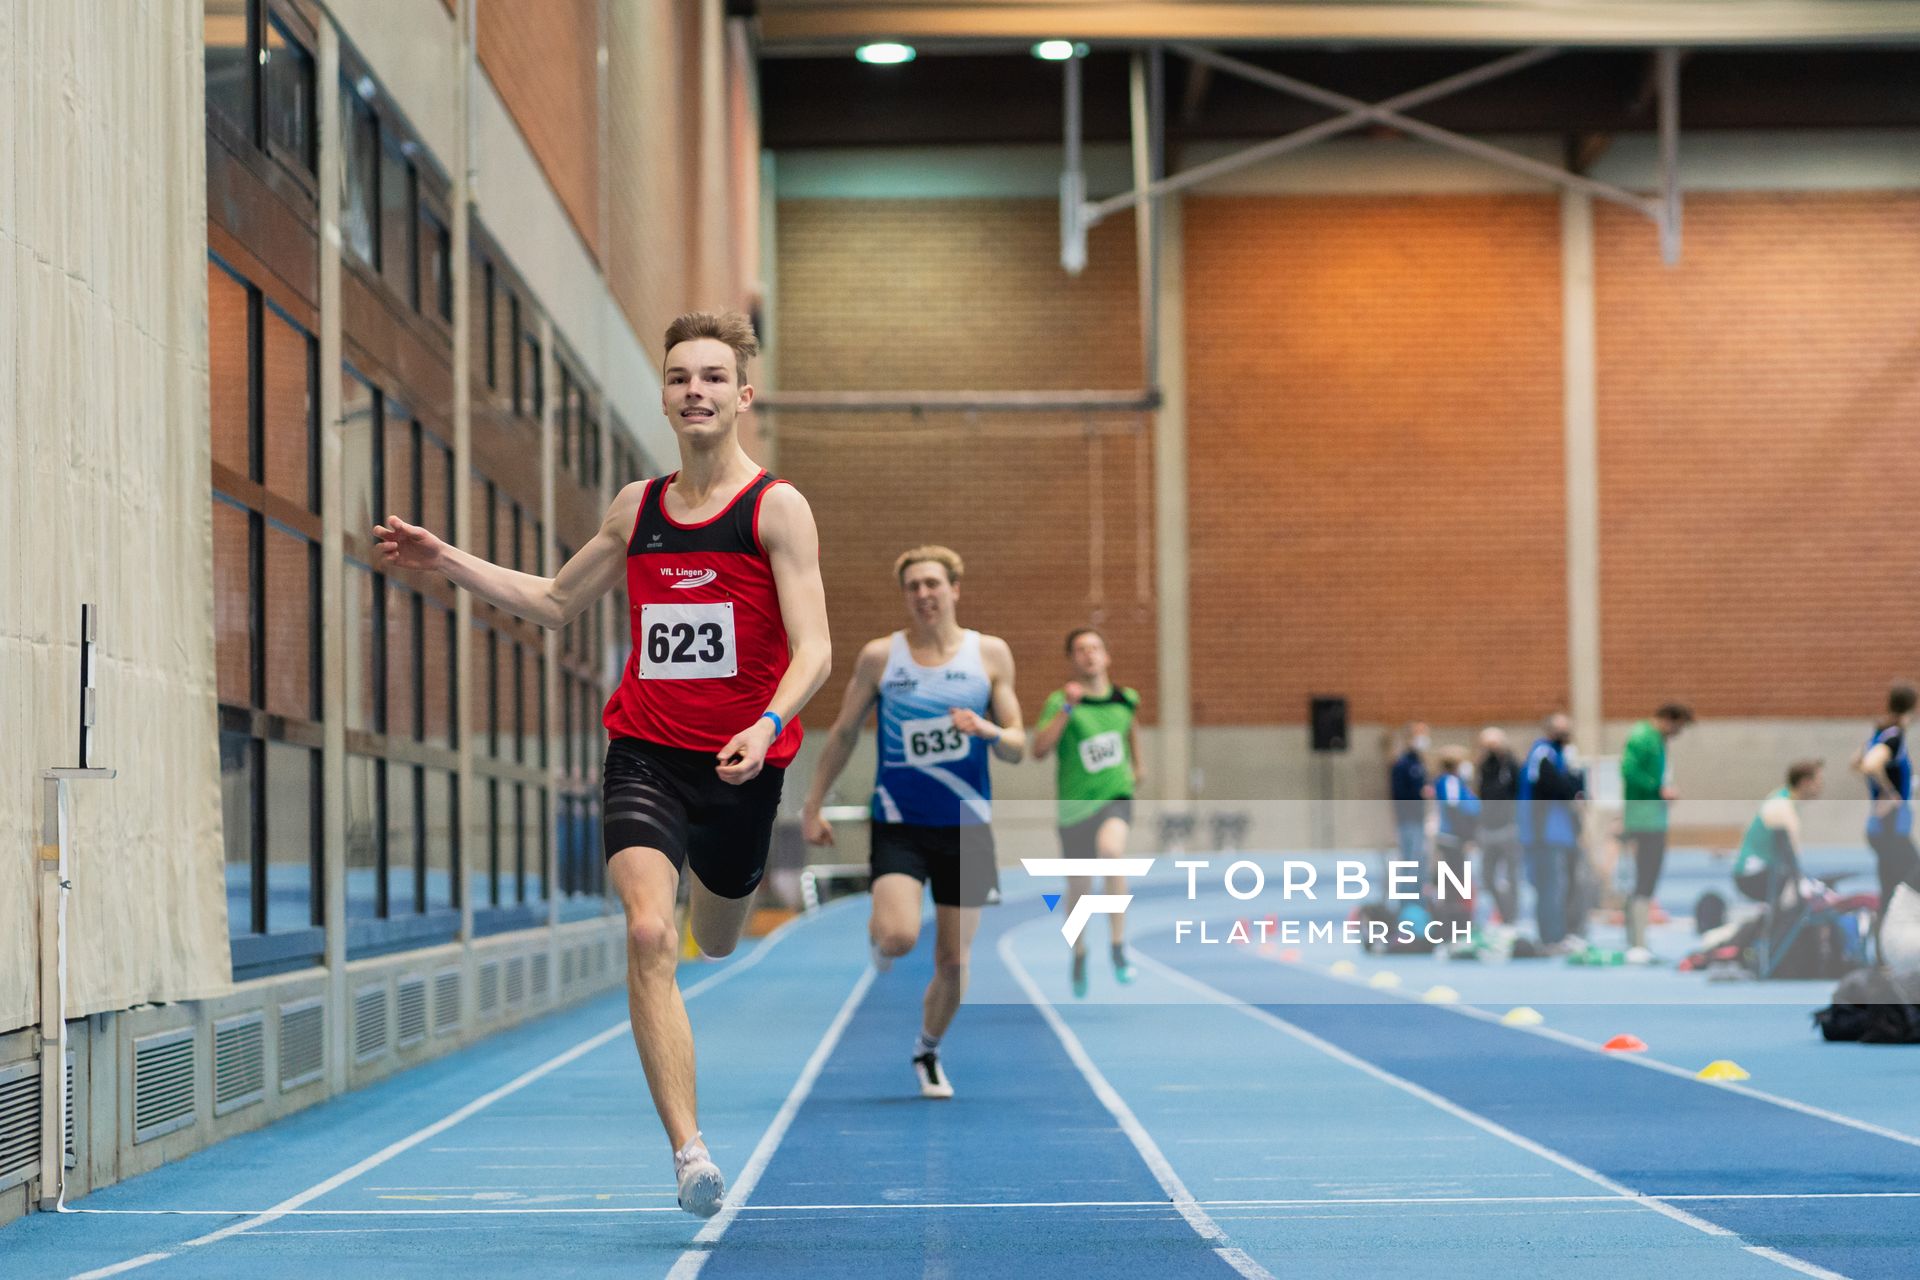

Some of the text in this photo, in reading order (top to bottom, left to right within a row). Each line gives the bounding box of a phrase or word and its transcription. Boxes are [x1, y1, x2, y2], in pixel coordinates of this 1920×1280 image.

[660, 568, 703, 578] VfL Lingen
[648, 622, 725, 664] 623
[911, 726, 963, 756] 633
